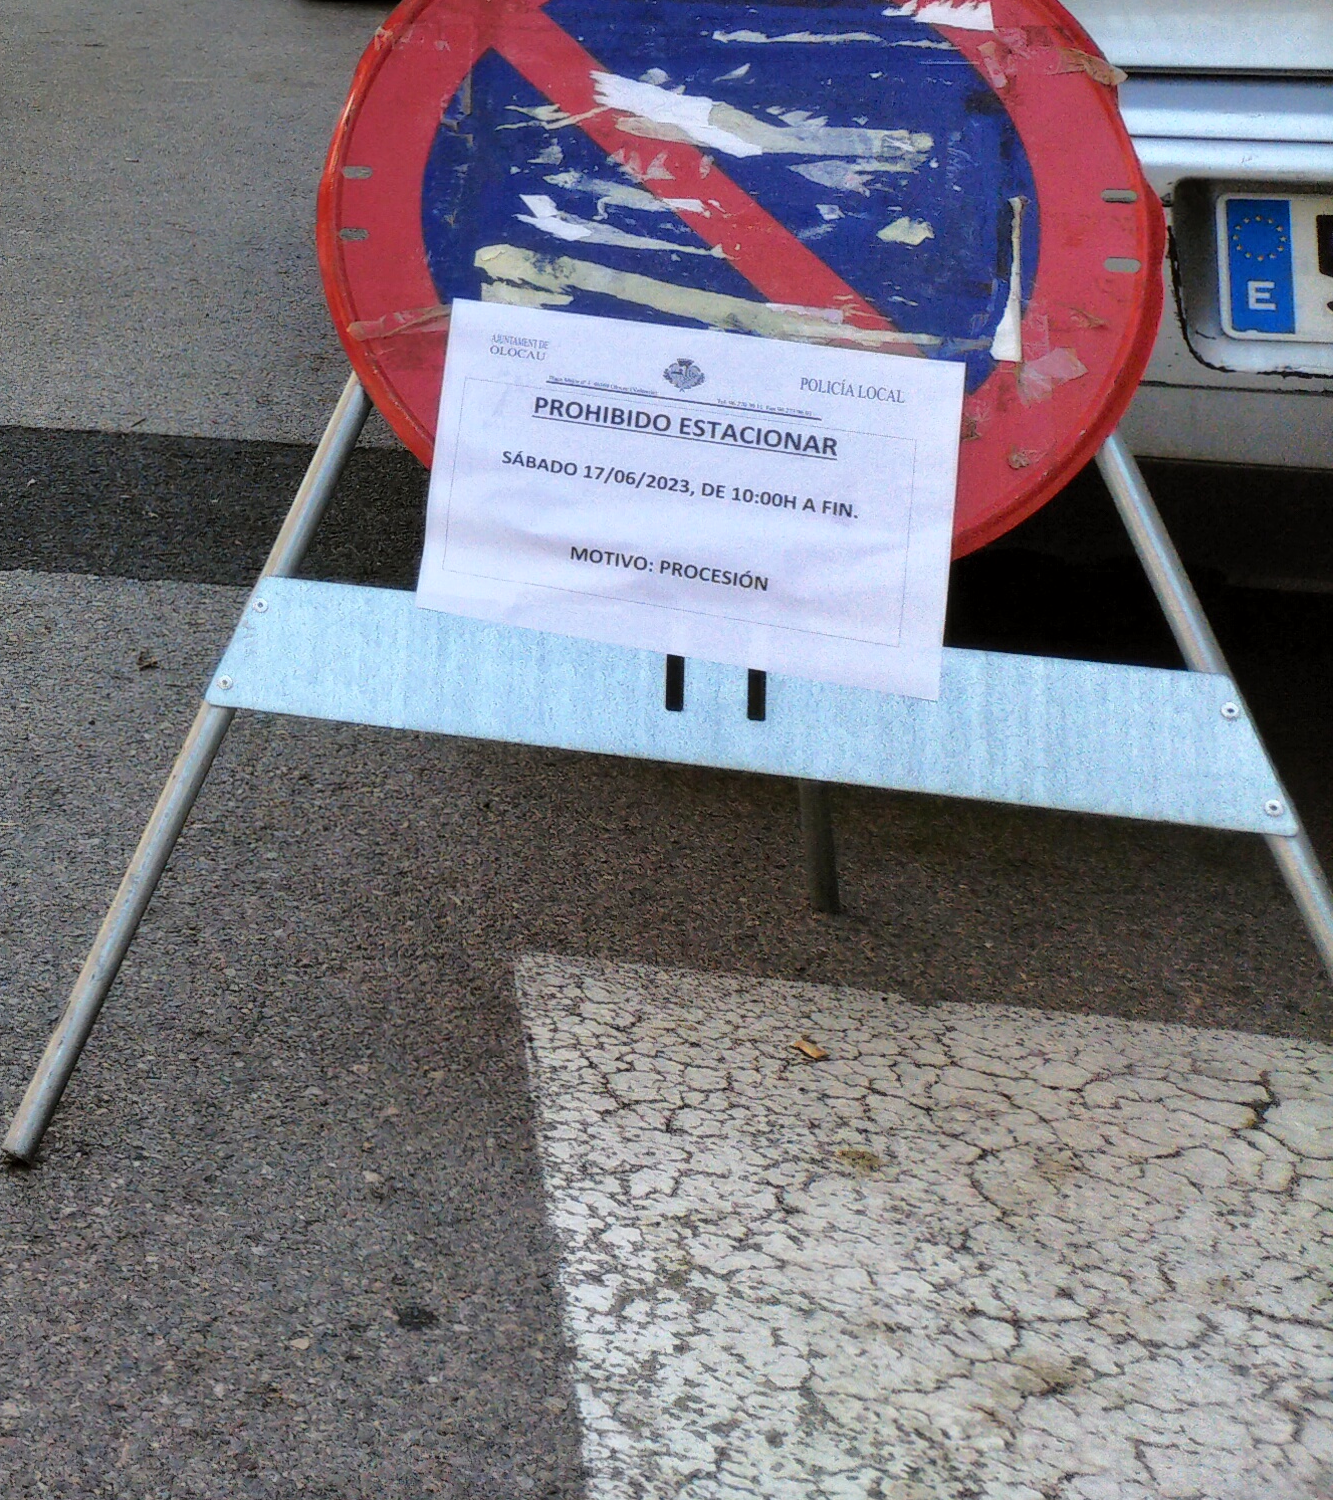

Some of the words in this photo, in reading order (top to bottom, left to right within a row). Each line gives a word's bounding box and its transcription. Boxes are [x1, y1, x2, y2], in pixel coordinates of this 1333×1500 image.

[1247, 280, 1277, 311] E
[489, 344, 547, 361] OLOCAU
[799, 377, 855, 398] POLICÍA
[857, 385, 906, 404] LOCAL
[534, 396, 672, 432] PROHIBIDO
[679, 416, 838, 457] ESTACIONAR
[502, 450, 578, 476] SÁBADO
[583, 465, 695, 497] 17/06/2023,
[701, 482, 726, 499] DE
[731, 487, 797, 510] 10:00H
[802, 498, 816, 513] A
[821, 500, 859, 519] FIN.
[570, 546, 654, 572] MOTIVO:
[659, 560, 769, 591] PROCESIÓN
